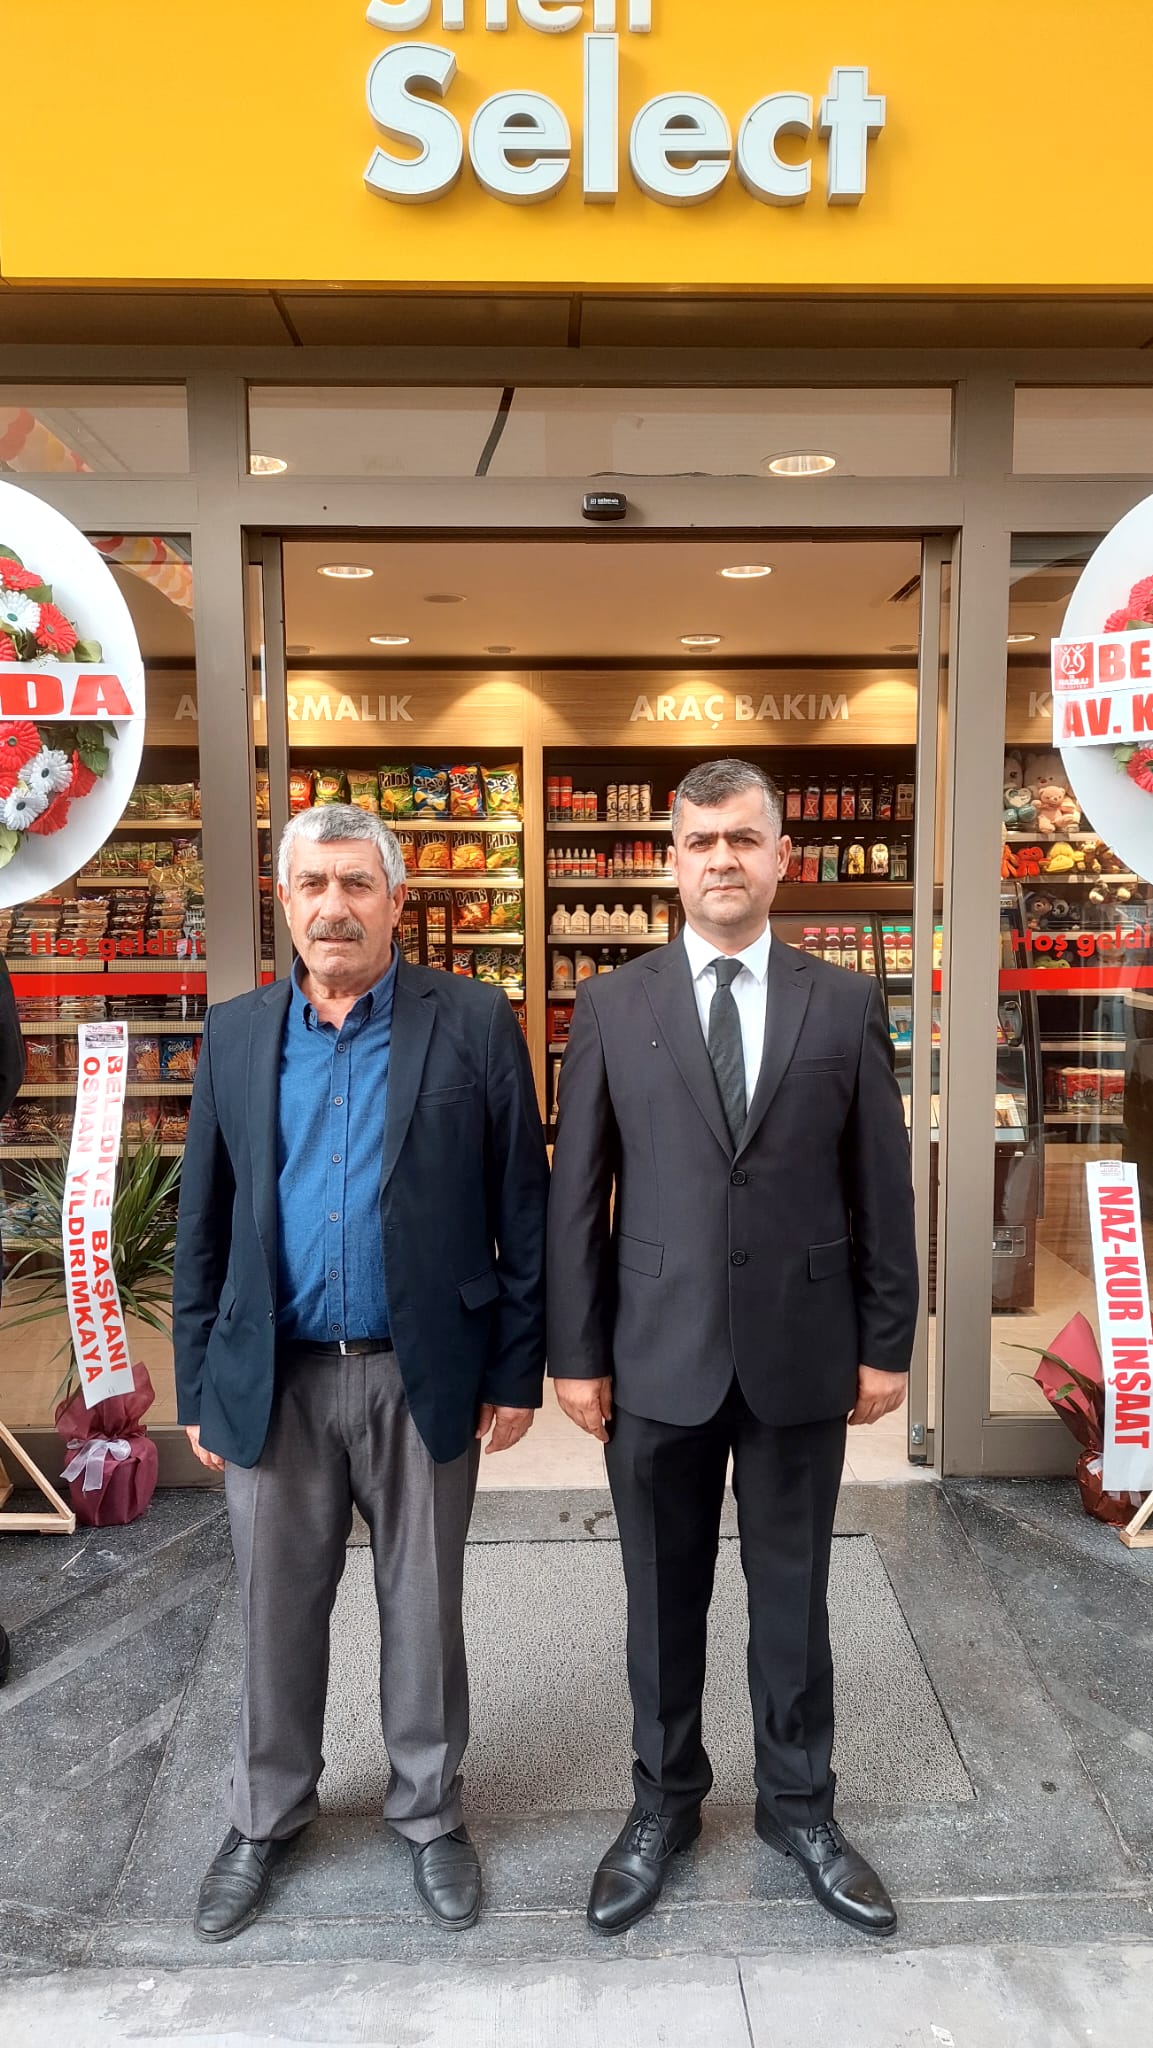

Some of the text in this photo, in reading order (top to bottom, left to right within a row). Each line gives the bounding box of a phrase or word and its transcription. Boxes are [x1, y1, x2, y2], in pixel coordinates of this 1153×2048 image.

[364, 33, 886, 206] Select
[629, 693, 850, 730] ARAÇ BAKIM
[1062, 697, 1121, 738] AV.
[30, 931, 89, 961] Hoş
[1011, 922, 1153, 958] Hoş geldi
[68, 1056, 104, 1384] OSMAN YILDIRIMKAYA
[1098, 1185, 1144, 1321] NAZ-KUR
[91, 1230, 128, 1372] BAŞKANI
[1108, 1336, 1153, 1449] İNŞAAT
